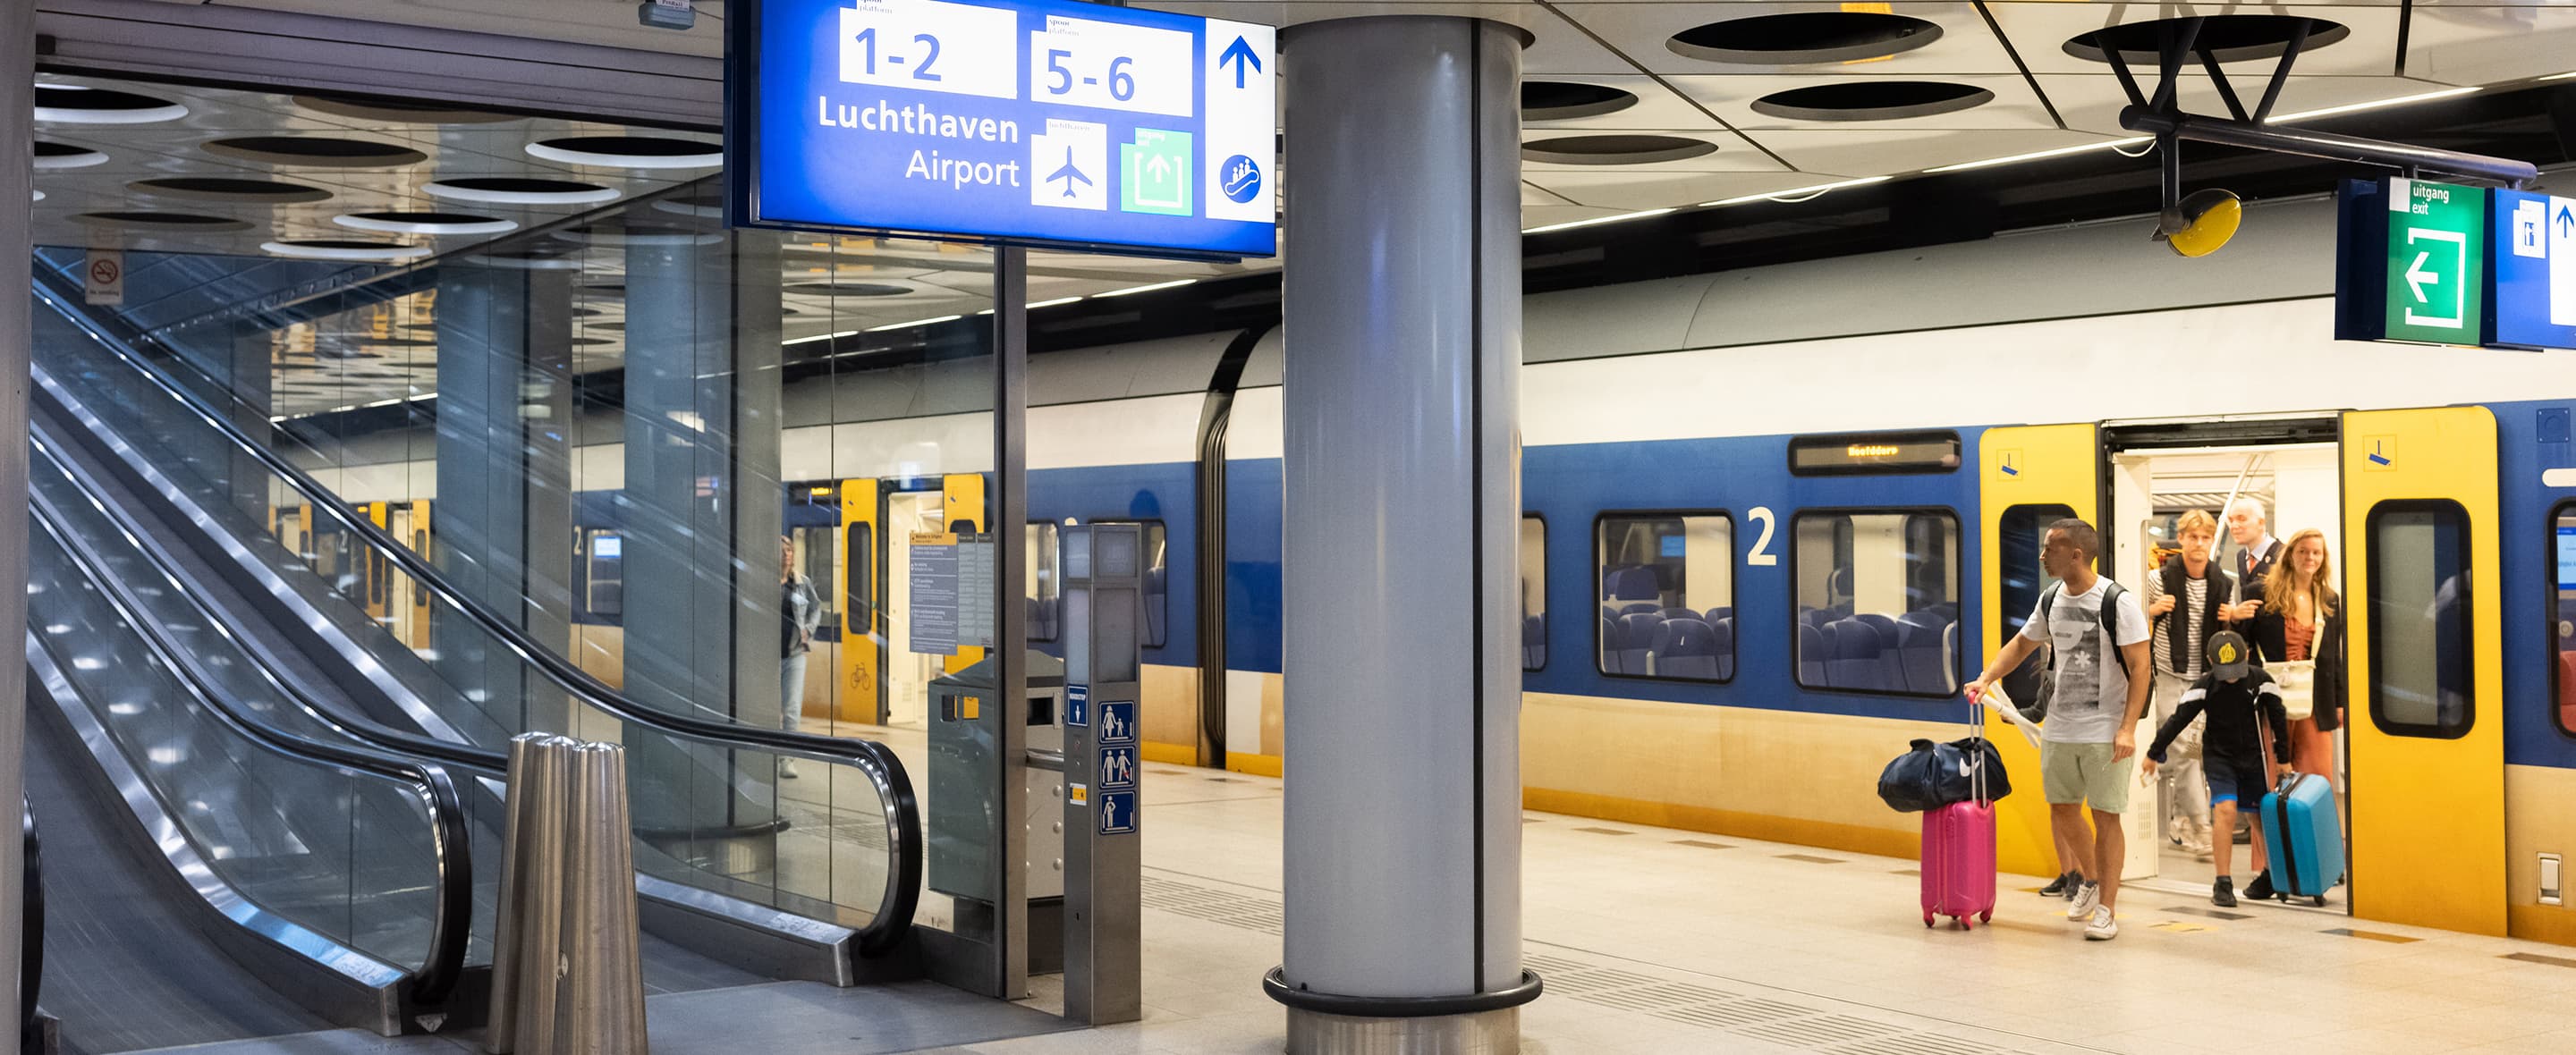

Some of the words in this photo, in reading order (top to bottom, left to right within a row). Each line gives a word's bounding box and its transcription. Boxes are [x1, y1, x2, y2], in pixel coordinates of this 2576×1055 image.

[818, 96, 1019, 143] Luchthaven
[905, 149, 1021, 190] Airport
[2411, 200, 2429, 215] exit
[2413, 183, 2450, 204] uitgang
[574, 525, 582, 555] 2
[1747, 506, 1777, 566] 2
